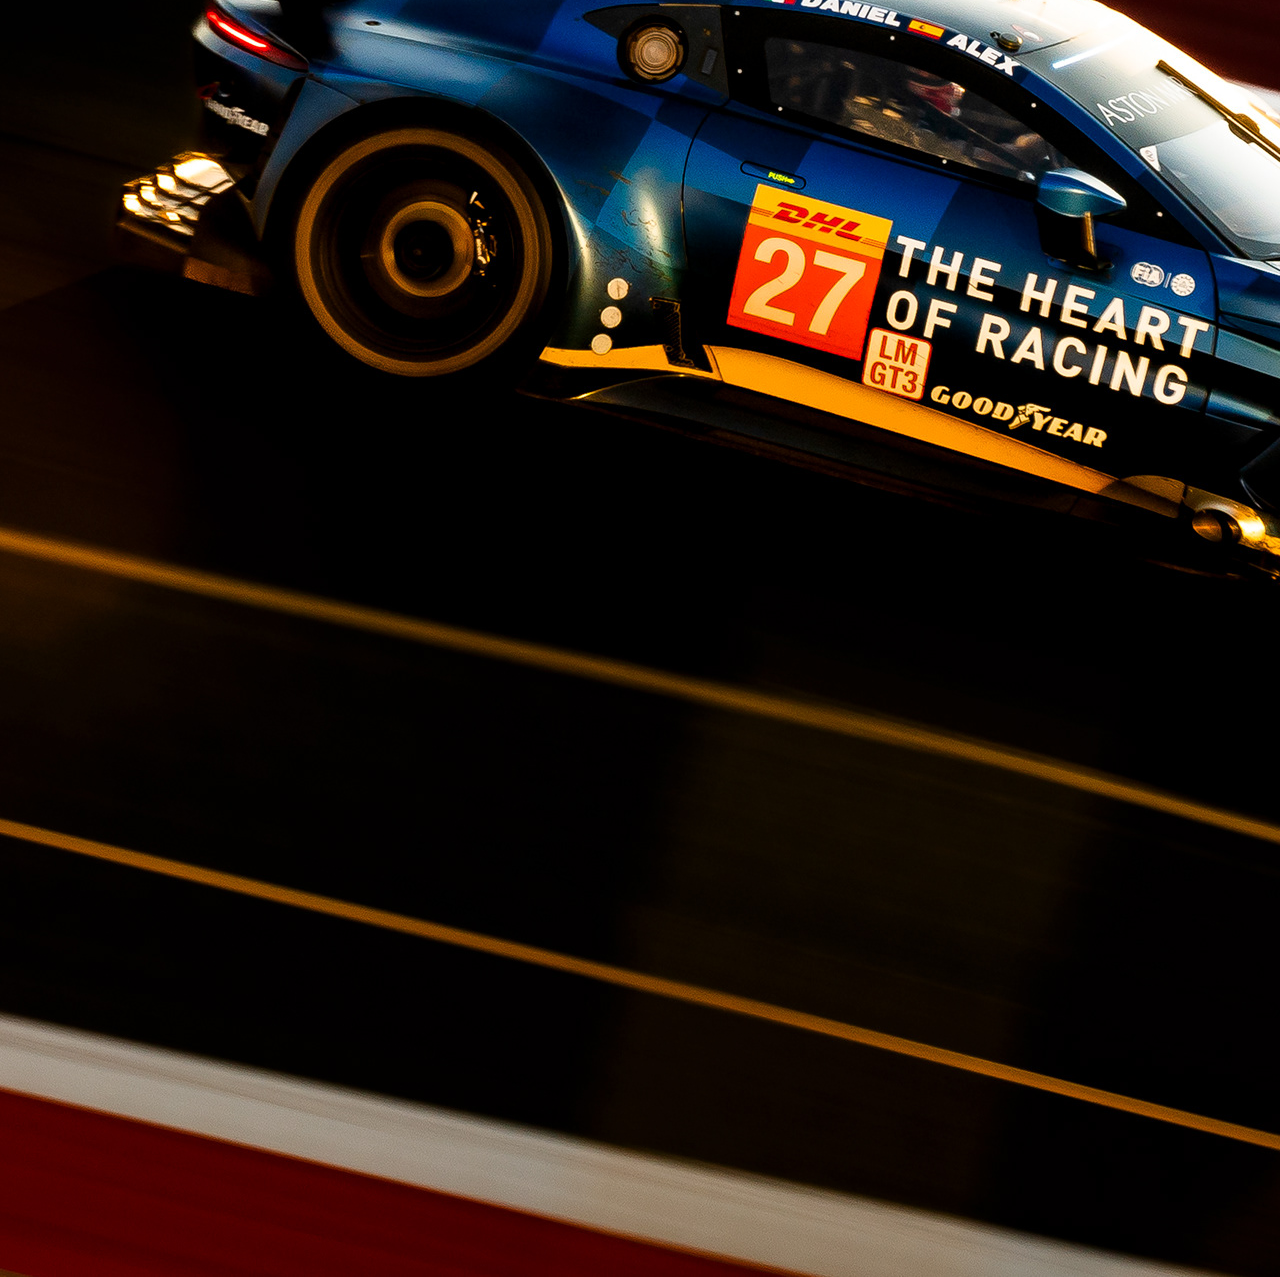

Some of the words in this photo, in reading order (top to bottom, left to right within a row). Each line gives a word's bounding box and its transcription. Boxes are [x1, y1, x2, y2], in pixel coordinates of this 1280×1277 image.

[946, 34, 1020, 76] ALEX
[1097, 86, 1171, 127] ASTON
[767, 171, 788, 183] PUSH
[772, 201, 862, 242] DHL
[743, 237, 867, 336] 27
[896, 235, 1002, 302] THE
[1019, 272, 1210, 359] HEART
[878, 335, 918, 367] LM
[886, 289, 958, 339] OF
[975, 313, 1189, 405] RACING
[870, 360, 918, 394] GT3
[930, 385, 1108, 448] GOODYEAR
